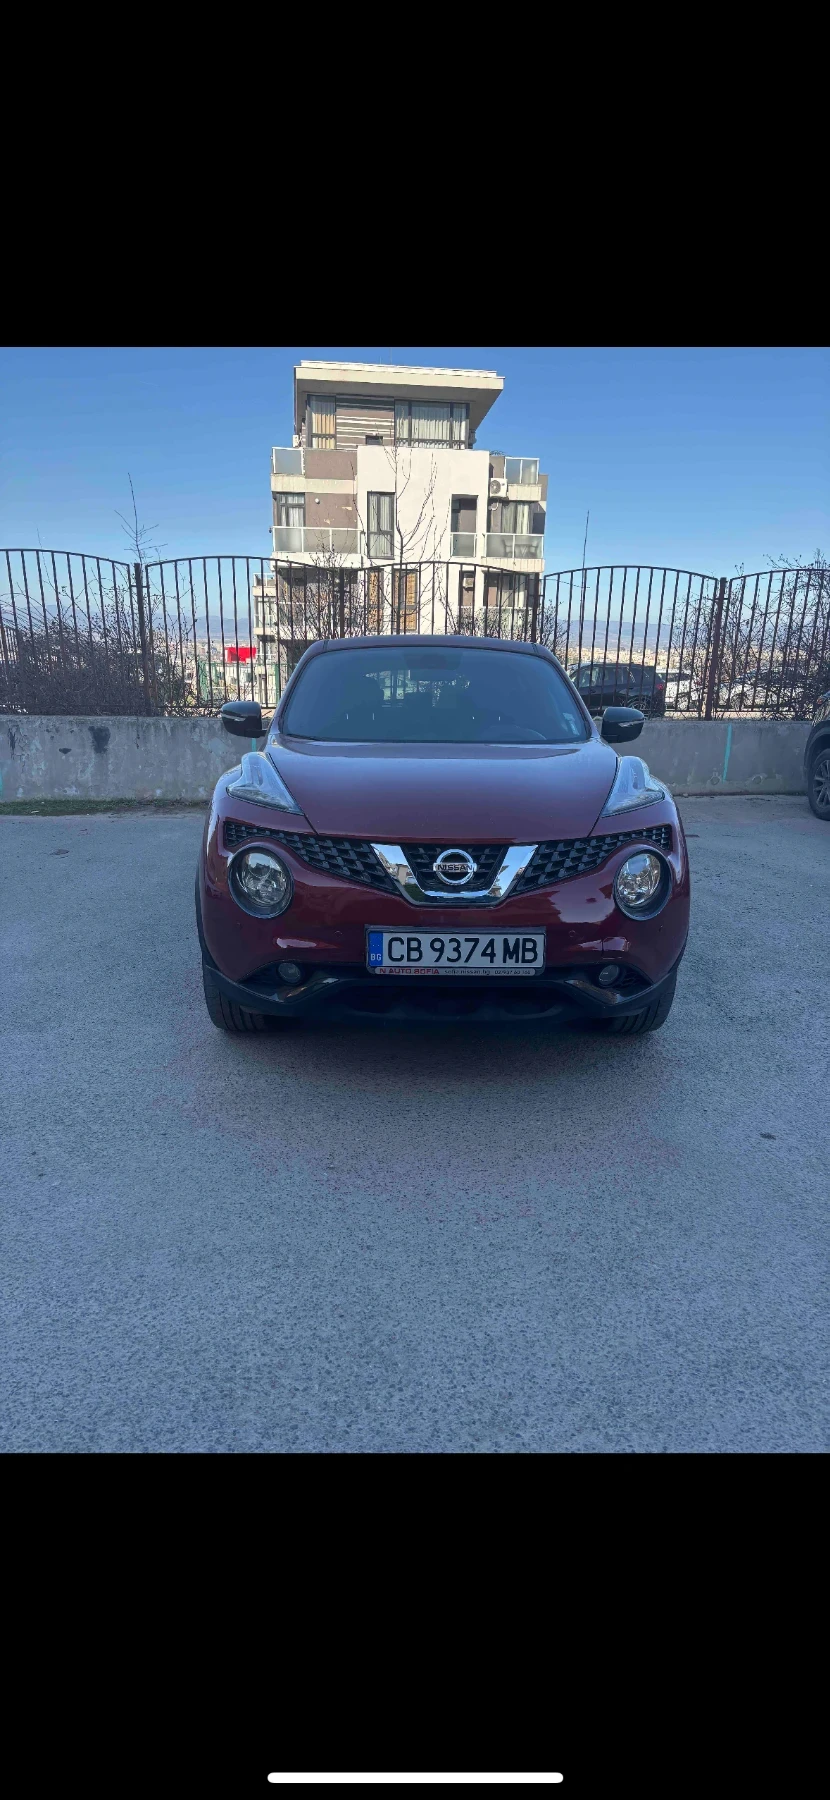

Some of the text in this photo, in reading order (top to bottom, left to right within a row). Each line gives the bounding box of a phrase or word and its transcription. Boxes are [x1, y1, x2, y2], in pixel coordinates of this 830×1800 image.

[370, 953, 382, 961] BG
[388, 937, 538, 963] CB 9374 MB
